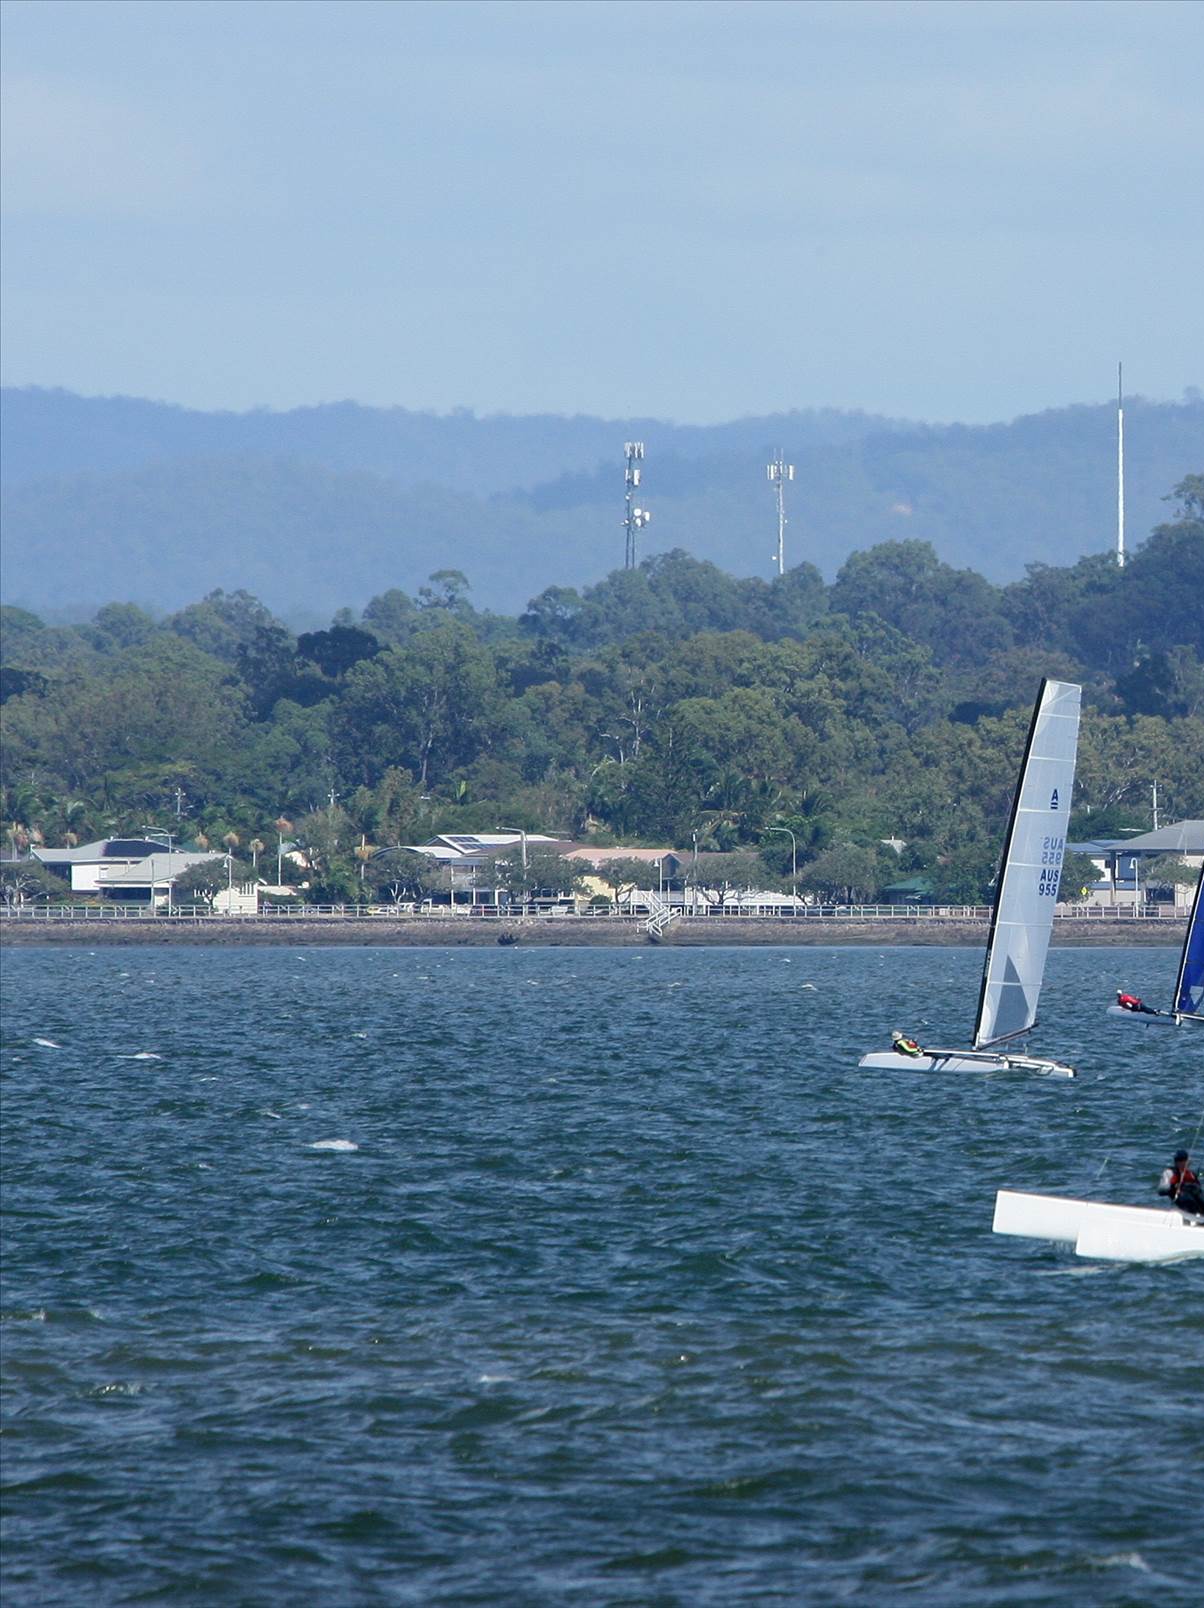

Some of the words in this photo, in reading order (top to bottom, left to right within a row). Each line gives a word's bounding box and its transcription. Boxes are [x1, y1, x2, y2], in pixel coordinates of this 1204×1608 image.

[1051, 789, 1059, 801] A
[1040, 868, 1059, 882] AUS
[1039, 883, 1057, 896] 955
